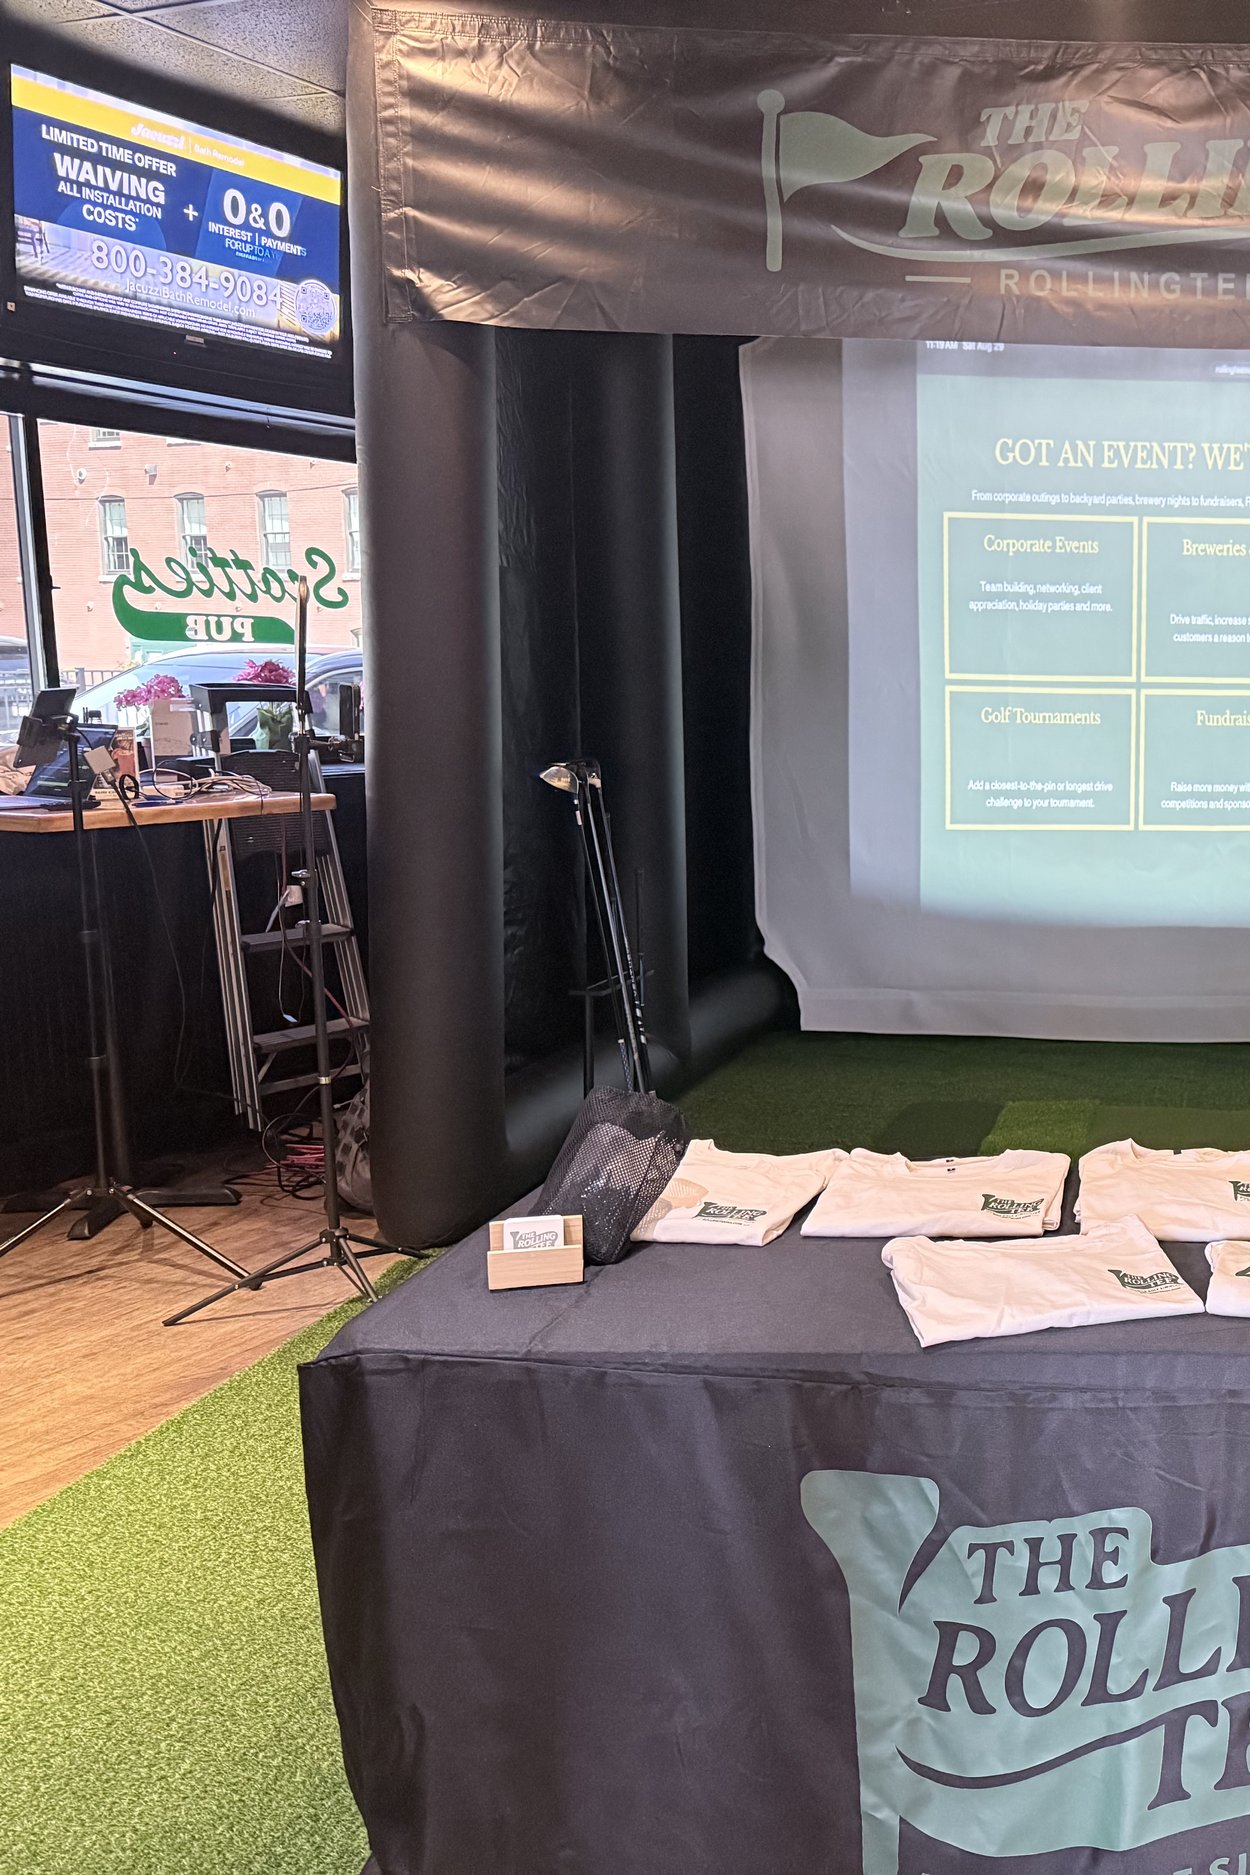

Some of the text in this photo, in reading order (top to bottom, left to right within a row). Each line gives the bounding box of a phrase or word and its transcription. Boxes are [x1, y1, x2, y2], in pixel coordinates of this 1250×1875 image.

[979, 100, 1089, 146] THE
[41, 123, 177, 177] LIMITED TIME OFFER
[54, 152, 166, 205] WAIVING
[57, 181, 162, 220] ALL INSTALLATION
[208, 221, 252, 242] INTEREST
[225, 238, 241, 250] FOR
[242, 243, 254, 253] UP
[254, 246, 264, 256] TO
[90, 239, 284, 311] 800-384-9084
[126, 279, 257, 319] JacuzziBathRemodel.com
[995, 438, 1054, 467] GOT
[1057, 440, 1097, 468] AN
[1101, 441, 1197, 470] EVENT?
[971, 490, 993, 502] From
[993, 491, 1031, 505] corporate
[1031, 492, 1061, 505] outings
[1061, 493, 1069, 503] to
[1069, 492, 1106, 506] backyard
[1106, 493, 1135, 507] parties,
[1135, 493, 1166, 508] brewery
[1191, 495, 1199, 506] to
[1199, 495, 1244, 508] fundraisers,
[983, 534, 1099, 556] Corporate Events
[1182, 539, 1246, 557] Breweries
[980, 580, 1102, 595] Team building, networking, client
[968, 600, 1113, 613] appreciation, holiday parties and more.
[1170, 614, 1190, 625] Drive
[1191, 614, 1214, 626] traffic,
[1214, 615, 1247, 627] increase
[1172, 632, 1212, 643] customers
[1219, 634, 1246, 643] reason
[980, 706, 1101, 725] Golf Tournaments
[967, 780, 984, 791] Add
[990, 780, 1057, 793] closest-to-the-pin
[1057, 782, 1065, 791] or
[1065, 781, 1094, 794] longest
[1094, 781, 1113, 792] drive
[1170, 782, 1192, 793] Raise
[1192, 784, 1213, 793] more
[1213, 784, 1238, 795] money
[986, 796, 1024, 810] challenge
[1024, 797, 1031, 808] to
[1031, 798, 1050, 809] your
[1161, 798, 1208, 811] competitions
[1209, 798, 1223, 809] and
[518, 1232, 556, 1248] ROLLING
[1124, 1273, 1176, 1284] ROLLING
[966, 1527, 1130, 1605] THE
